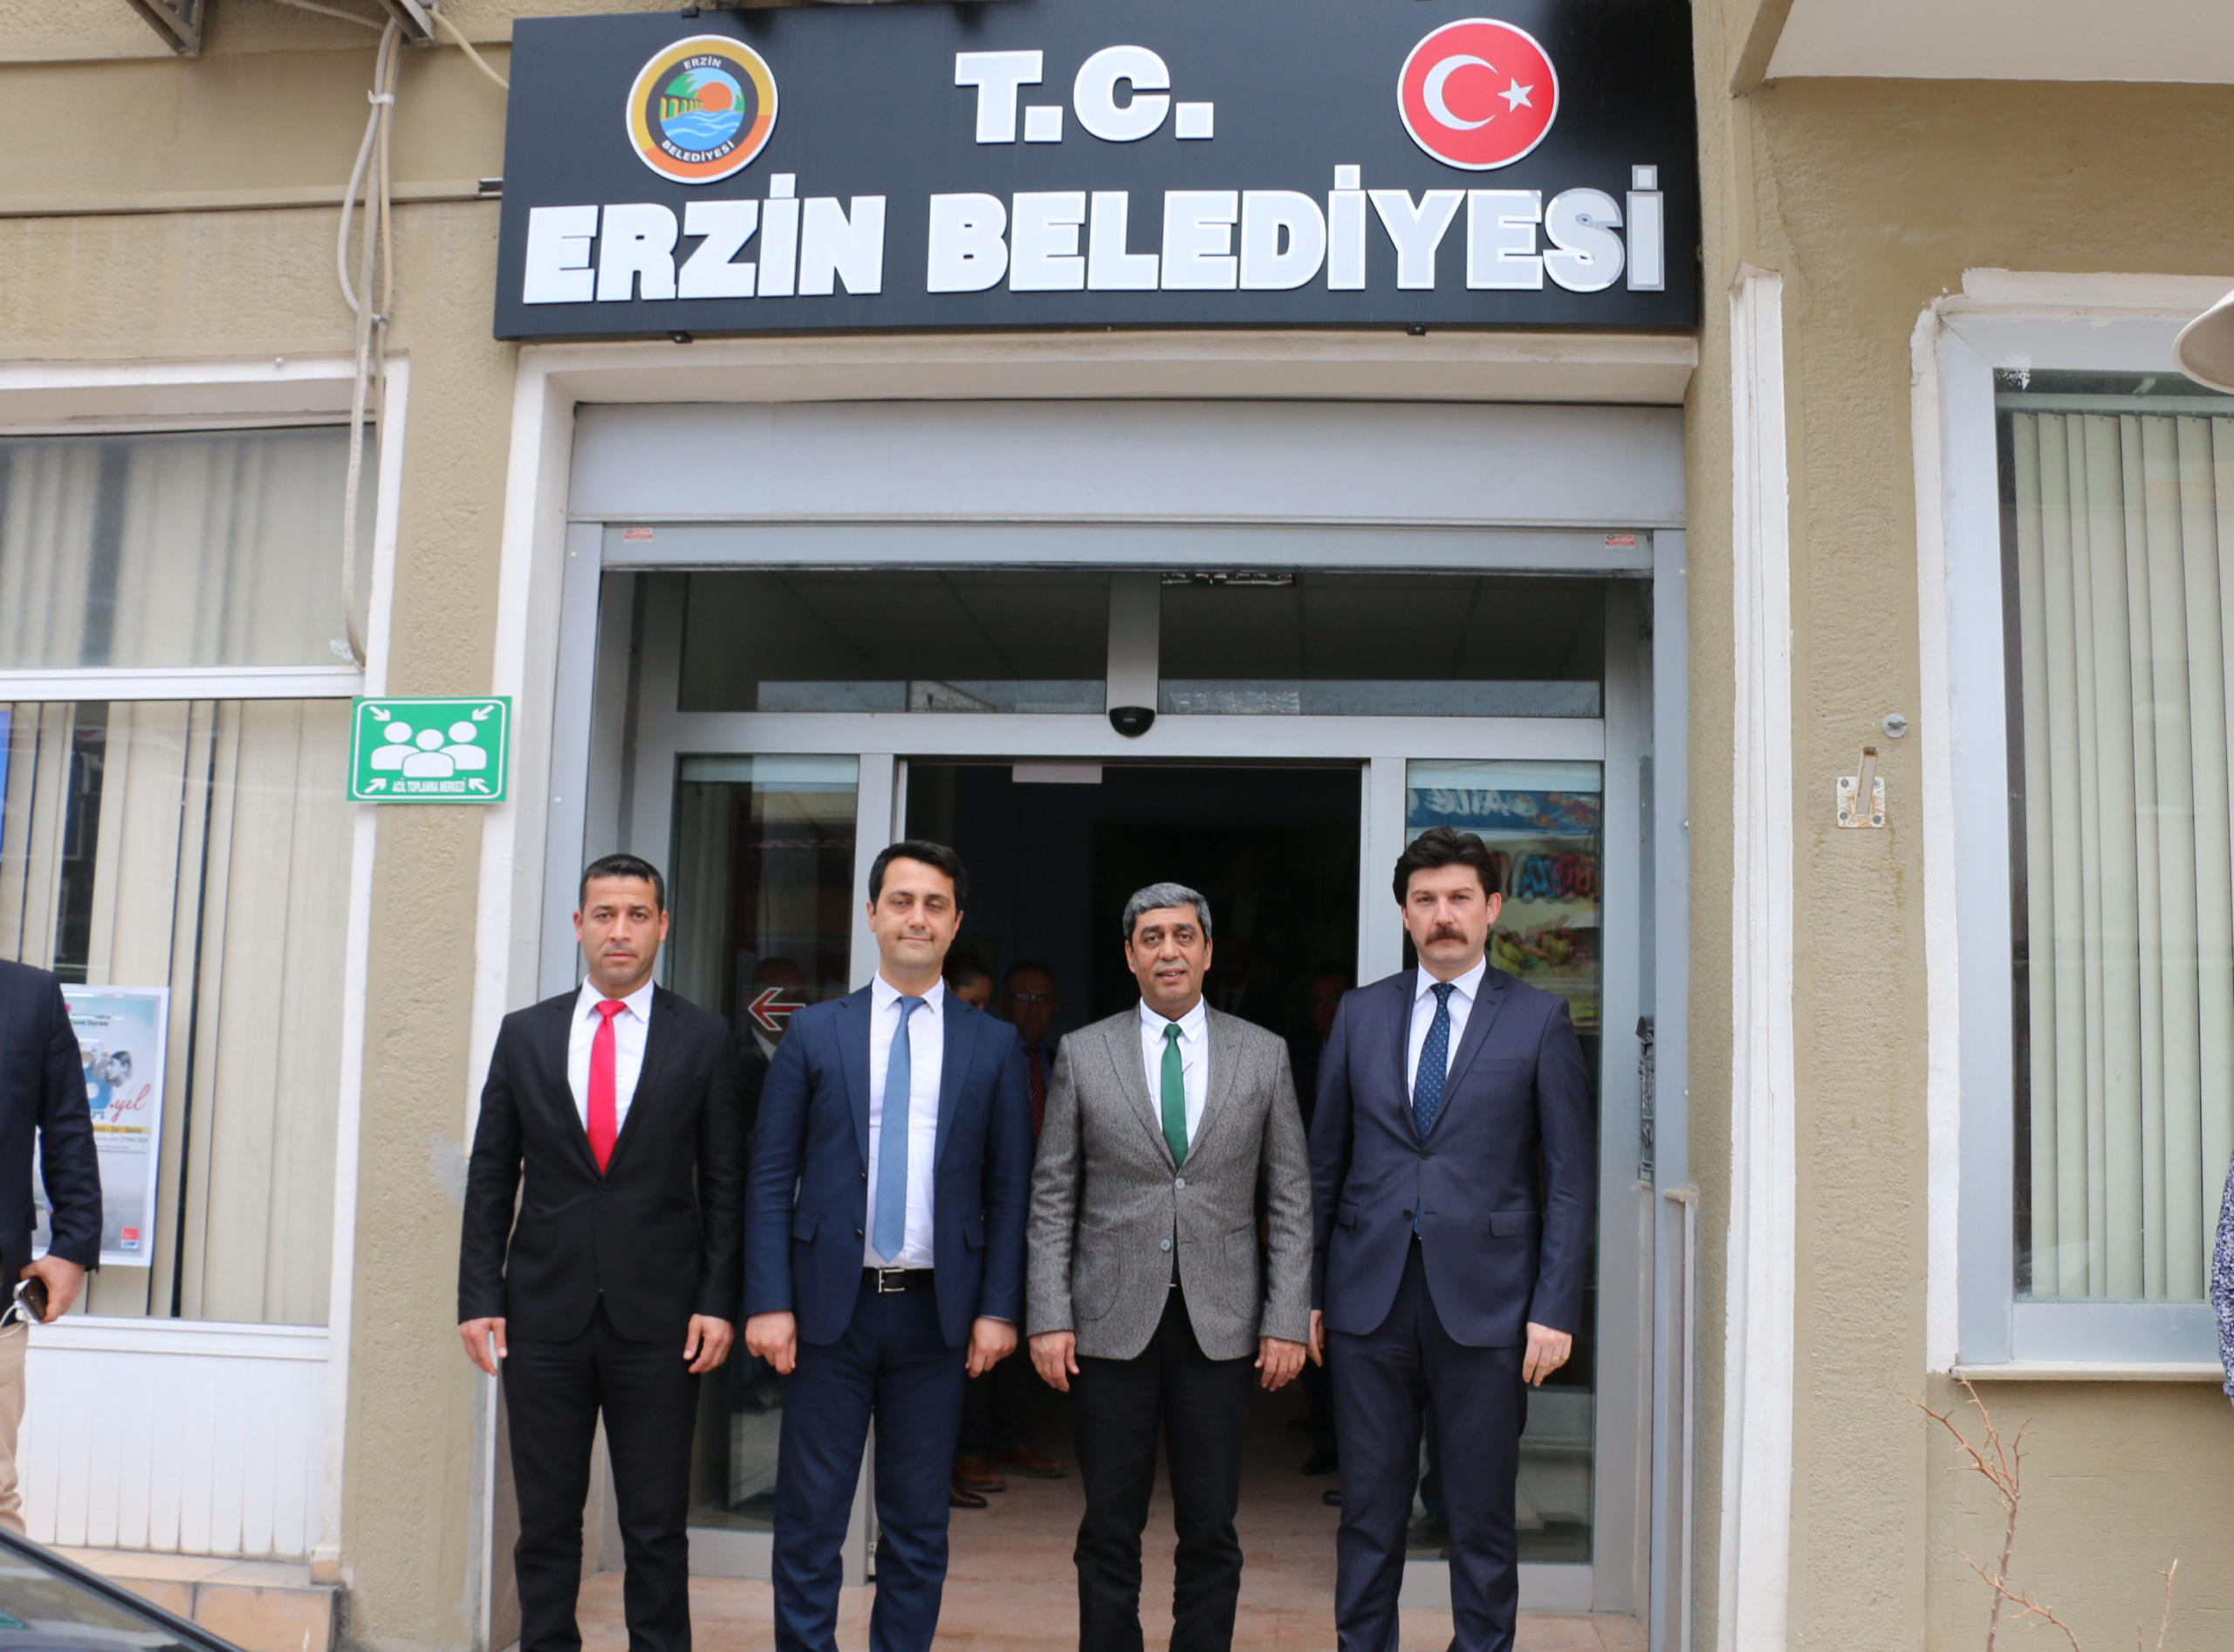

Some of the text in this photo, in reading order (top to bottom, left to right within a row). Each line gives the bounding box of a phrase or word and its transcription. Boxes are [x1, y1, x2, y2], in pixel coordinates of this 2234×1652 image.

[683, 56, 722, 69] ERZİN
[955, 44, 1214, 144] T.C.
[661, 140, 735, 161] BELEDİYESİ
[523, 163, 1666, 304] ERZİN BELEDİYESİ
